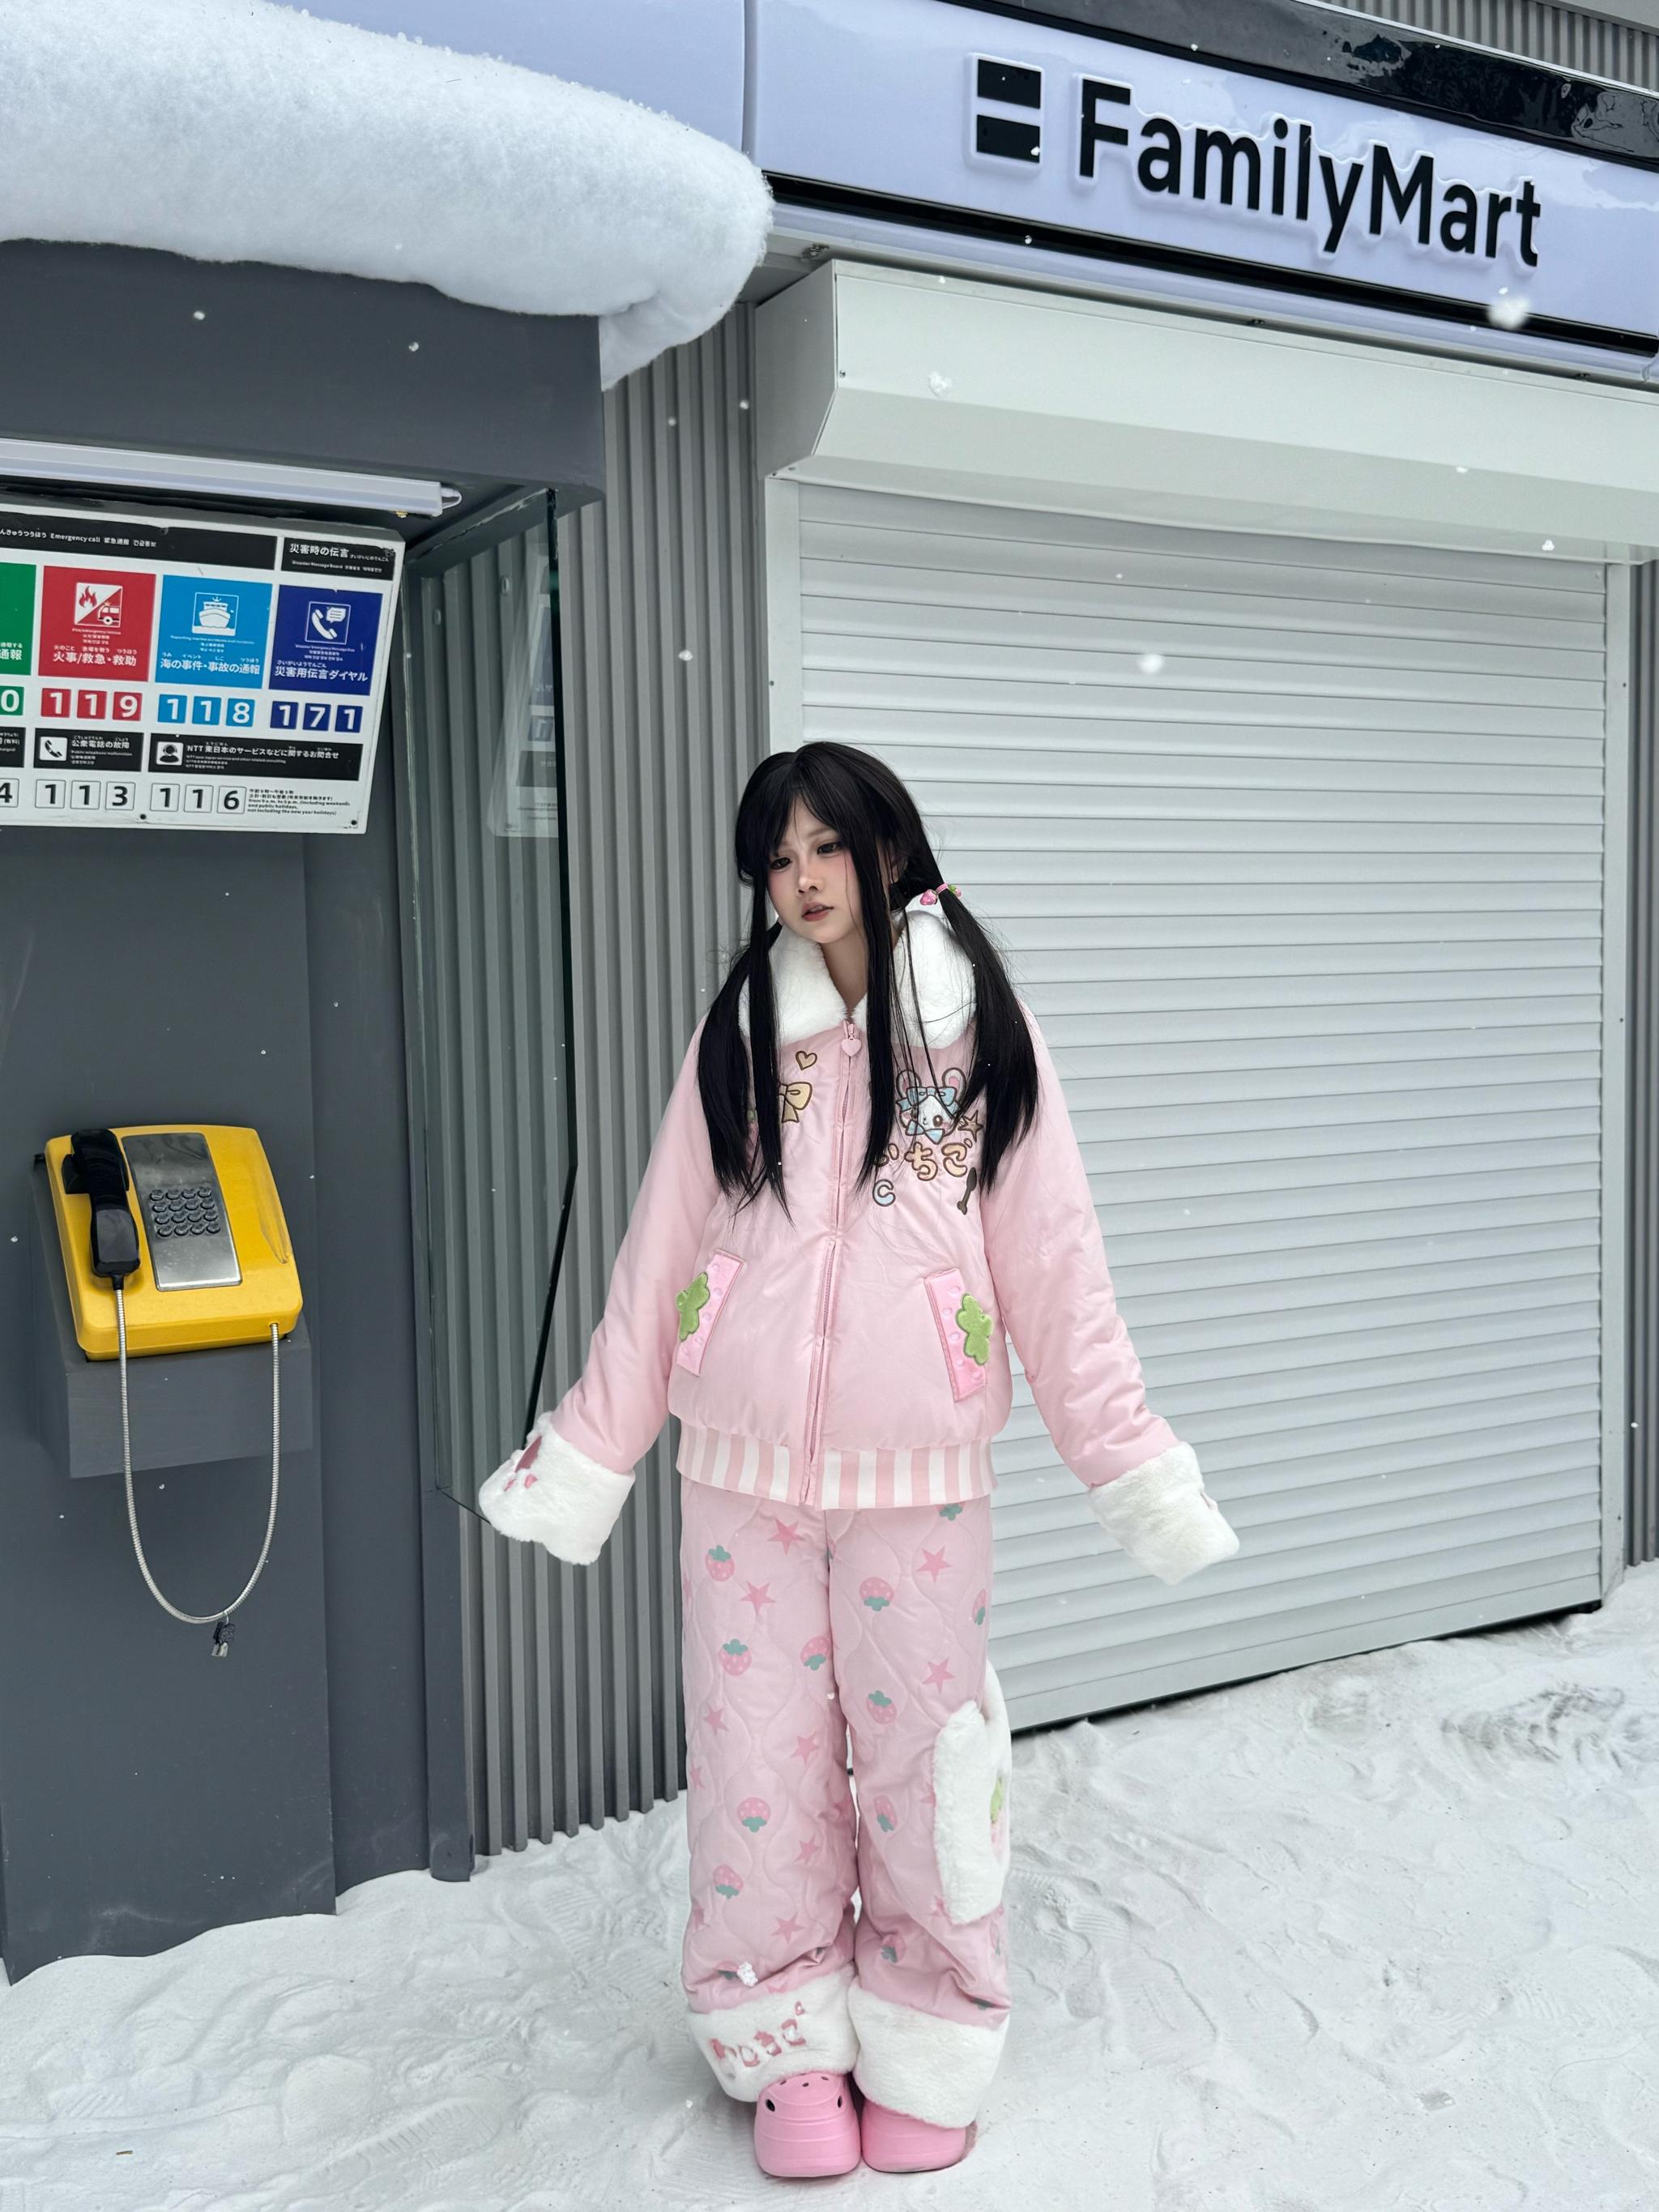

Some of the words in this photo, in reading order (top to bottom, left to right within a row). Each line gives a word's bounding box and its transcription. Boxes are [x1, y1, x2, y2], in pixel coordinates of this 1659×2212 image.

[1078, 79, 1542, 267] FamilyMart
[50, 532, 87, 544] Emergency
[290, 543, 350, 558] 災害時の伝言
[53, 651, 137, 666] 火事/救急・救助
[160, 658, 260, 675] 海の事件・事故の通報
[275, 665, 368, 681] 災害用伝言ダイヤル
[1, 689, 19, 712] 0
[50, 692, 139, 718] 119
[167, 698, 250, 724] 118
[279, 704, 356, 730] 171
[71, 739, 130, 749] 公衆電話の故障
[187, 745, 204, 753] NTT
[205, 745, 339, 759] 東日本のサービスなどに関するお問合せ
[0, 783, 12, 803] 4
[45, 784, 128, 806] 113
[160, 788, 240, 810] 116
